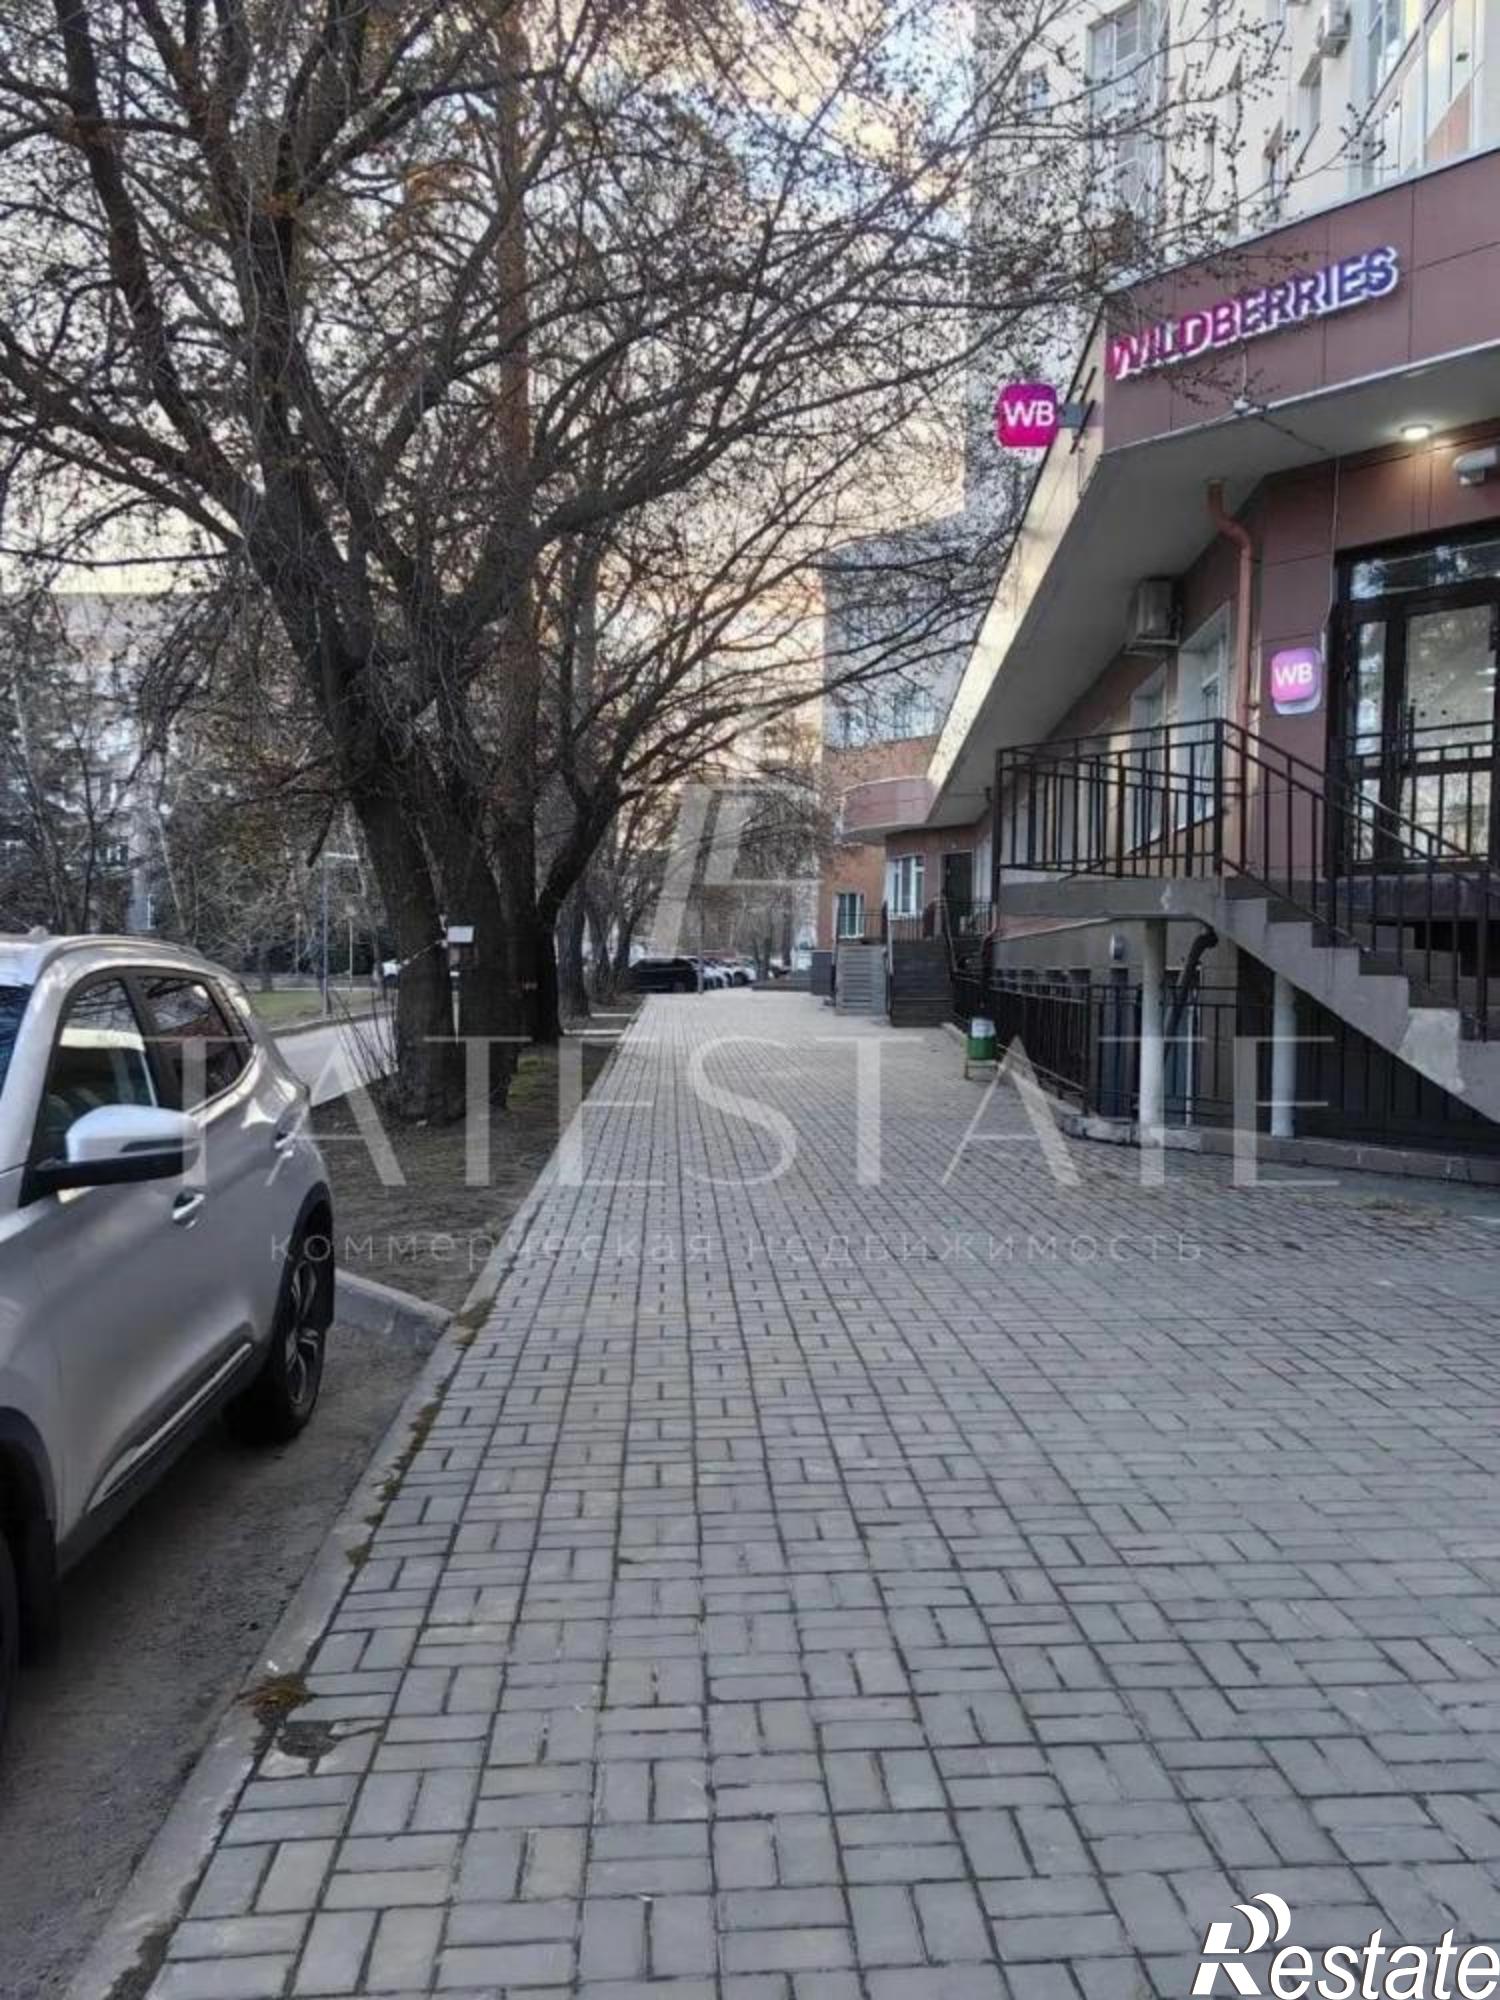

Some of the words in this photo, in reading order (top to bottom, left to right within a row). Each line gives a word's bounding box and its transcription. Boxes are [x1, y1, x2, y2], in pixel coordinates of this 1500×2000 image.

[1106, 246, 1398, 380] WILDBERRIES
[1003, 400, 1055, 427] WB
[1275, 662, 1312, 687] WB
